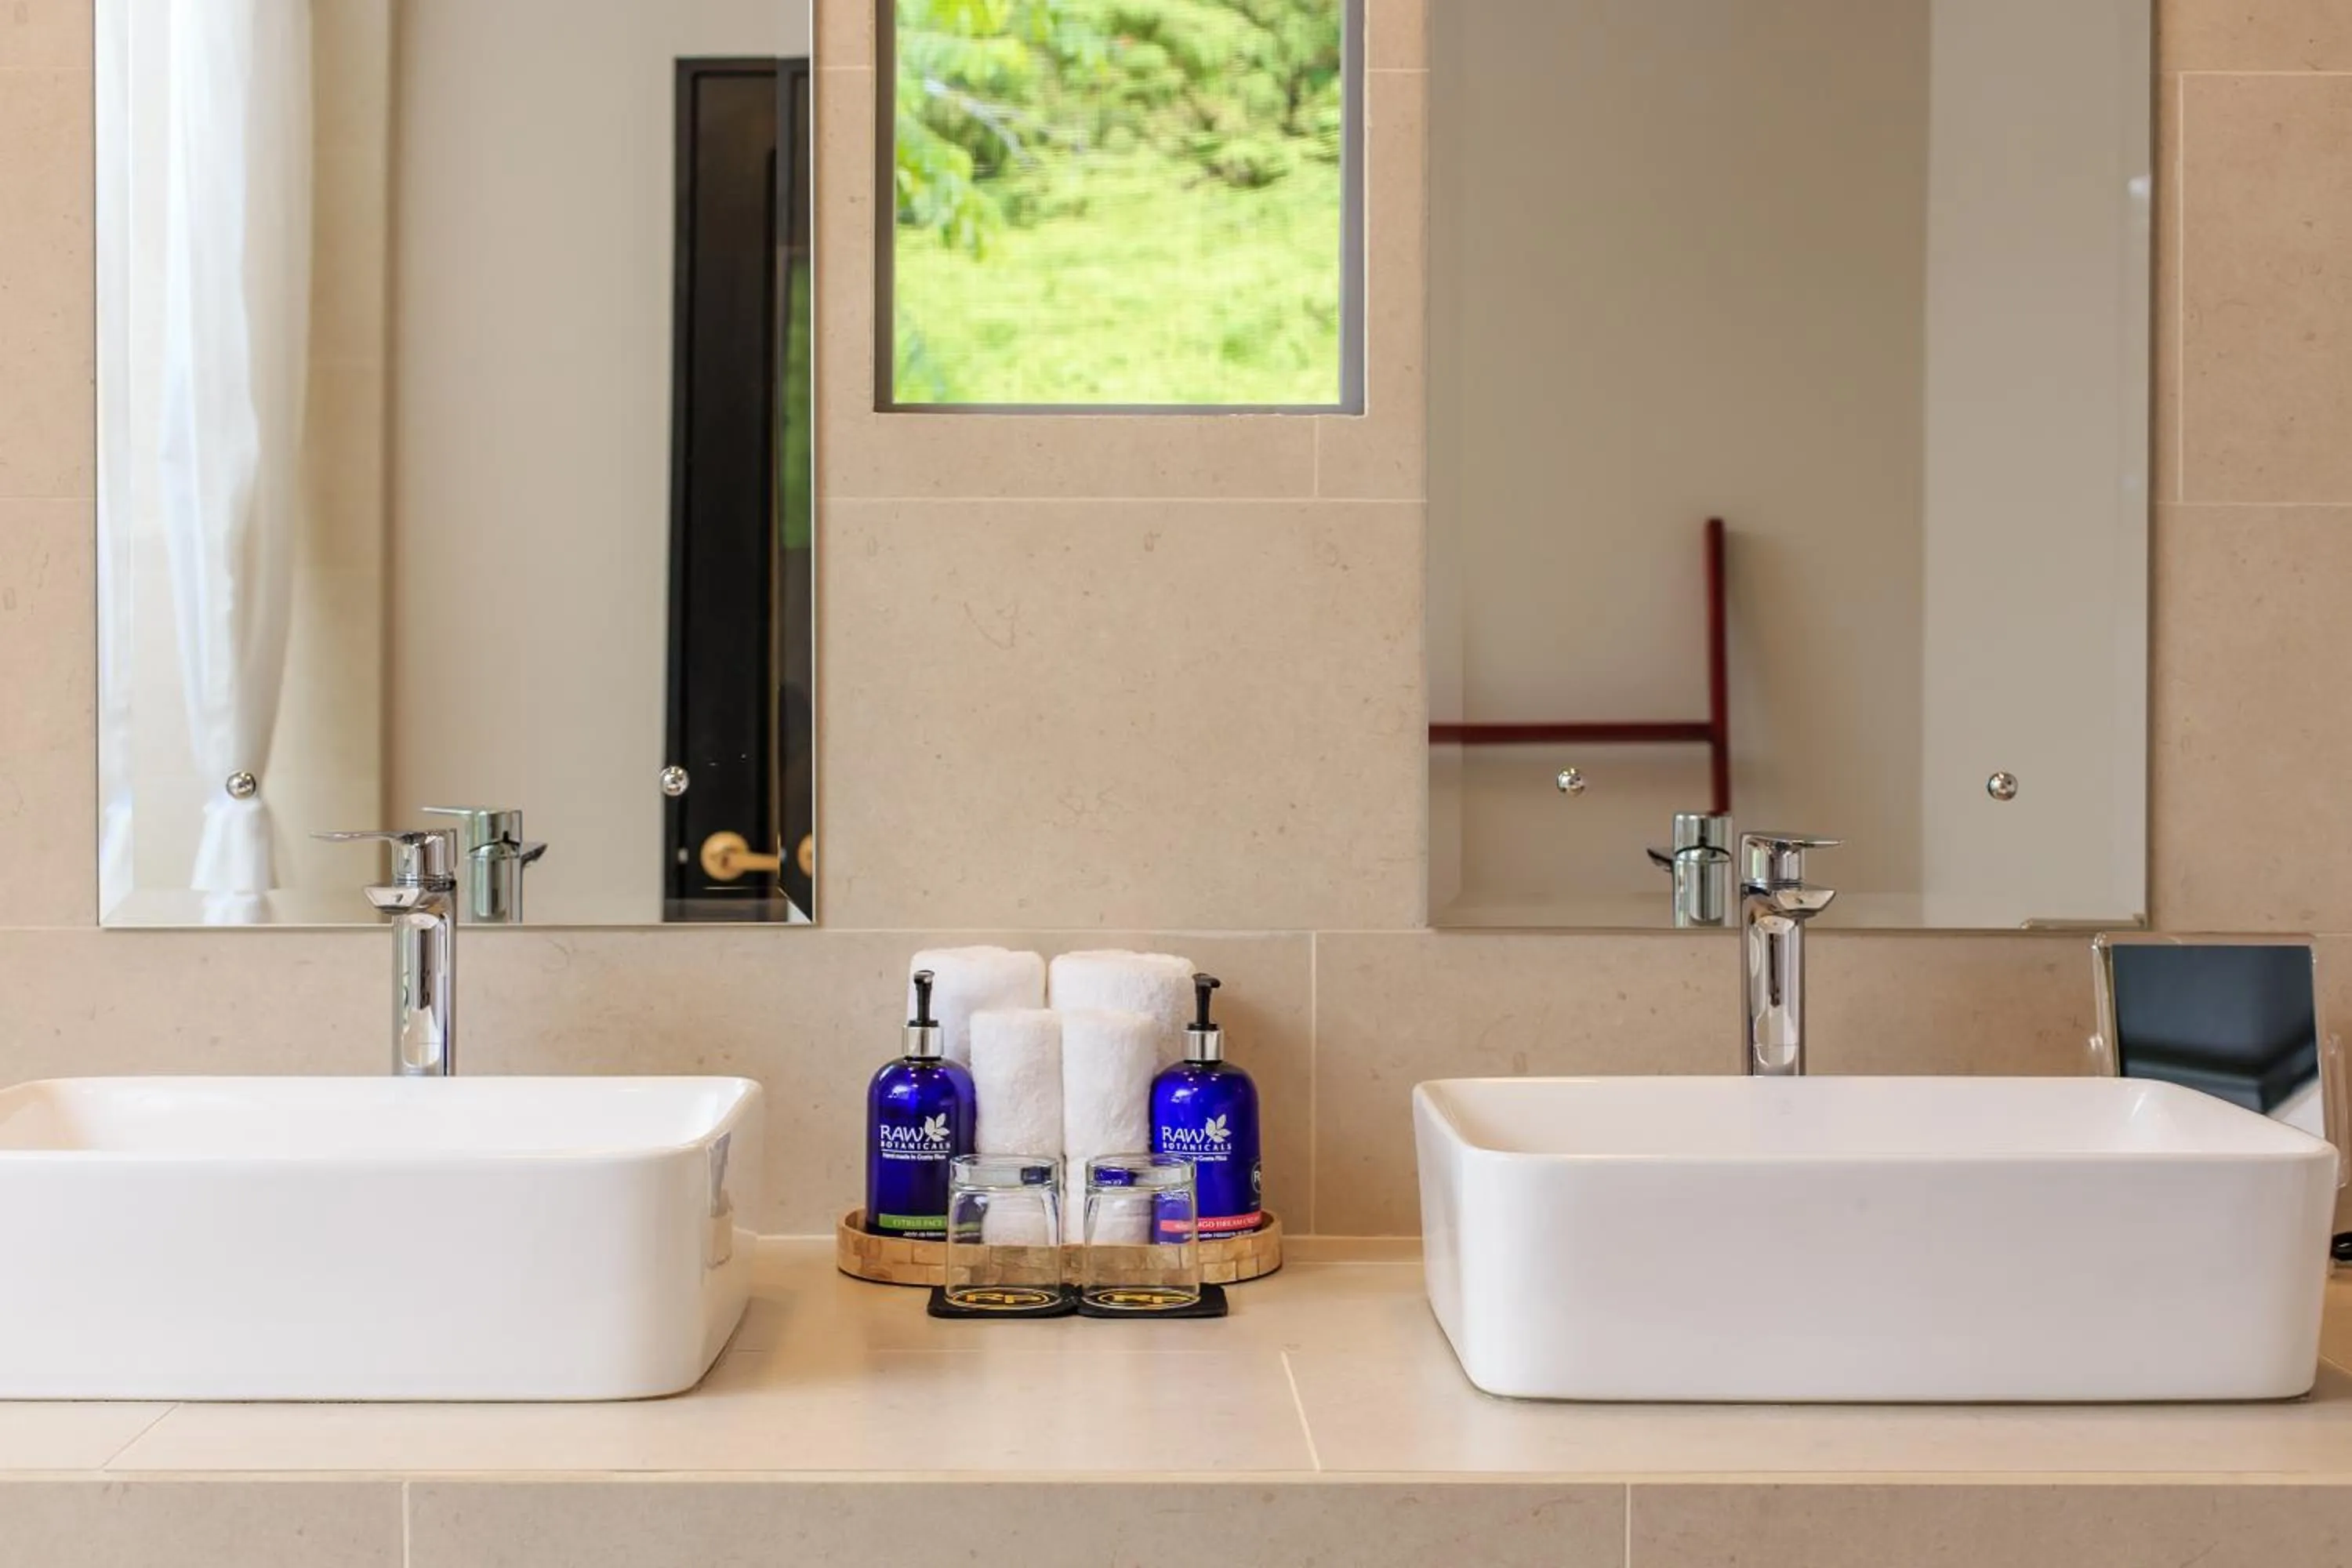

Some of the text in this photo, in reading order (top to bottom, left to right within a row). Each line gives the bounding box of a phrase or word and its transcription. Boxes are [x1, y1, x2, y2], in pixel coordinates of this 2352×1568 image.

[880, 1124, 924, 1142] RAW
[1161, 1126, 1205, 1144] RAW
[880, 1141, 951, 1150] BOTANICALS
[1163, 1142, 1232, 1151] BOTANICALS
